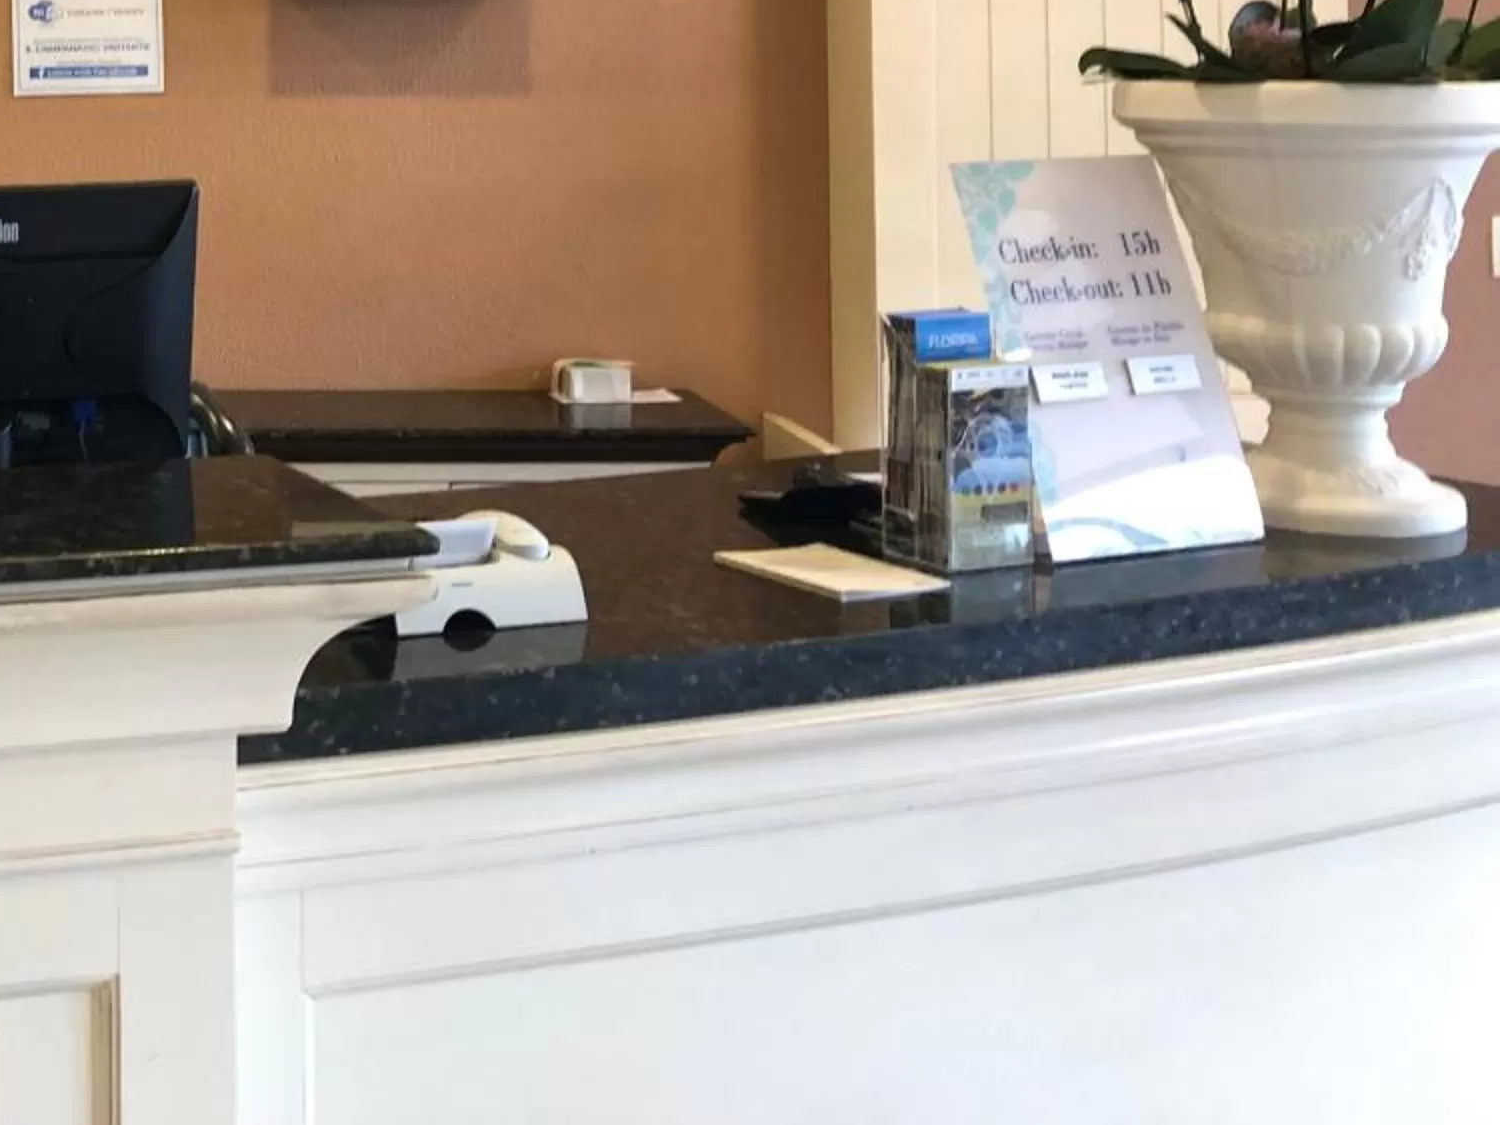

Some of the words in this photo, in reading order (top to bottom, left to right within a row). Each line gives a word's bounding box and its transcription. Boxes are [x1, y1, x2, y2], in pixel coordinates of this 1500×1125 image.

[998, 235, 1099, 263] Check-in:
[1119, 228, 1161, 257] 15h
[1010, 276, 1124, 305] Check-out:
[1128, 269, 1172, 297] 11h
